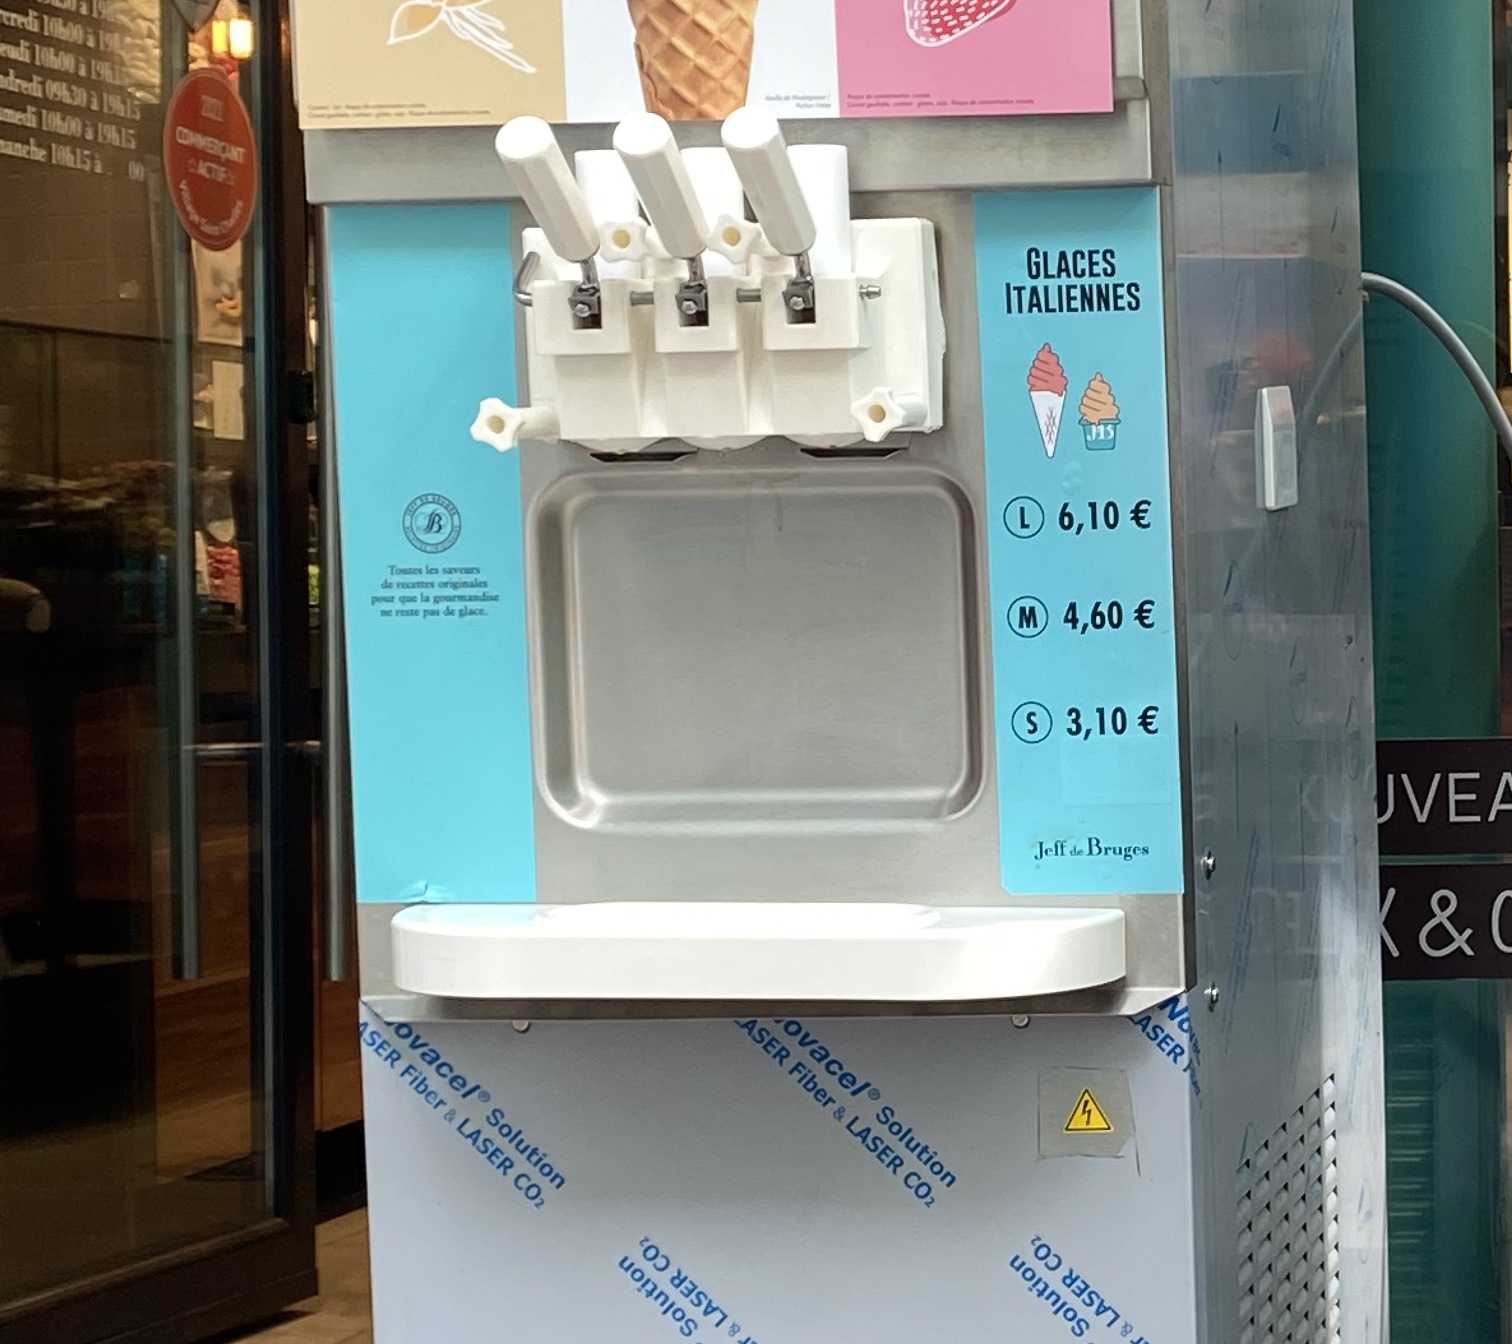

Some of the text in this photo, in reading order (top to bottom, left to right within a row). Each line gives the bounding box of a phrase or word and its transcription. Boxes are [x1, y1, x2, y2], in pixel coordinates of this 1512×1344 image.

[97, 122, 137, 150] 19h15
[1026, 247, 1116, 280] GLACES
[1005, 282, 1141, 314] ITALIENNES
[1058, 501, 1119, 536] 6,10
[1130, 499, 1152, 529] €
[381, 577, 488, 590] de recettes originales
[388, 563, 481, 576] Toutes les saveurs
[370, 594, 395, 606] pour
[398, 594, 418, 606] que
[433, 591, 500, 605] gourmandise
[1063, 600, 1123, 635] 4,60
[1133, 599, 1155, 629] €
[1066, 705, 1128, 741] 3,10
[1137, 705, 1160, 734] €
[1034, 836, 1150, 861] Jeff de Bruges
[1418, 888, 1475, 957] &
[400, 1063, 448, 1110] Fiber
[455, 1116, 515, 1177] LASER
[788, 1060, 837, 1108] Fiber
[845, 1115, 905, 1176] LASER
[485, 1108, 566, 1190] Solution
[875, 1105, 957, 1189] Solution
[617, 1255, 699, 1338] Solution
[668, 1268, 729, 1330] LASER
[1008, 1254, 1090, 1338] Solution
[1061, 1267, 1121, 1329] LASER
